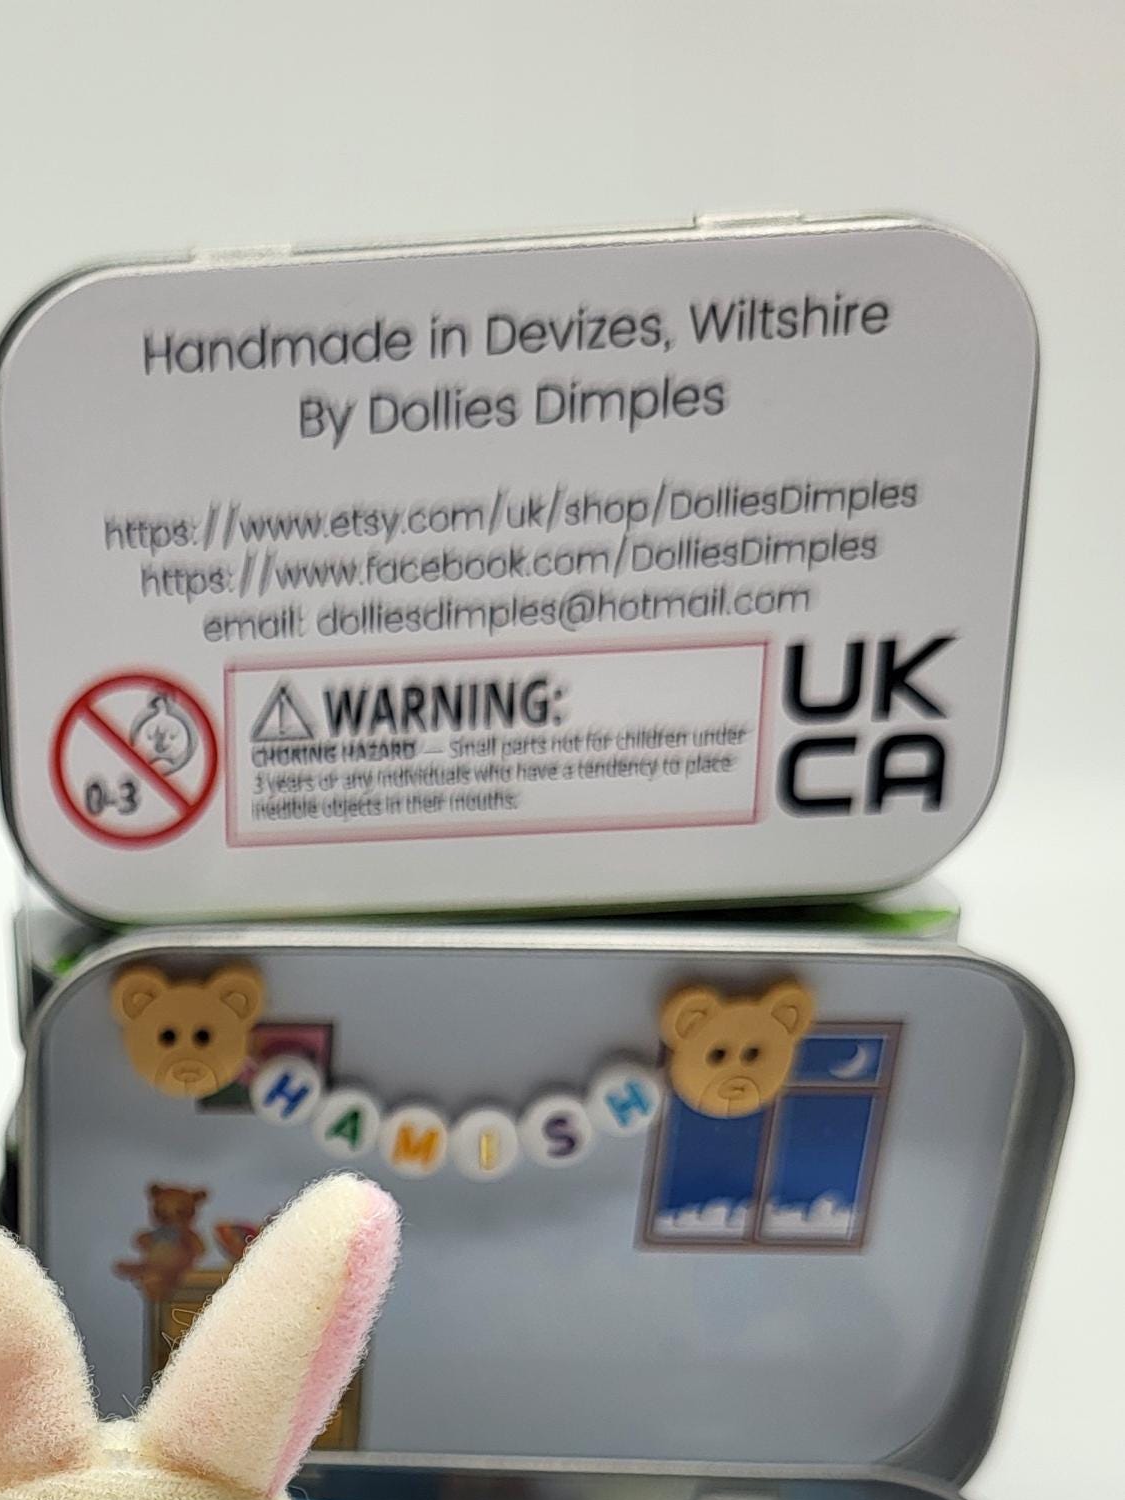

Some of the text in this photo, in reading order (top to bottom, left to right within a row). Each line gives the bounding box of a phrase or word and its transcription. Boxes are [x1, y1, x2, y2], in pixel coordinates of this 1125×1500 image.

[144, 291, 891, 376] Handmade in Devizes, Wiltshire
[299, 376, 727, 450] By Dollies Dimples
[103, 477, 918, 556] https://www.etsy.com/uk/shop/DolliesDimples
[140, 530, 878, 603] https://www.facebook.com/DolliesDimples
[203, 584, 812, 642] email: dolliesdimples@hotmail.com
[323, 678, 565, 738] WARNING:
[782, 635, 959, 725] UK
[251, 744, 336, 768] CHOKING
[342, 740, 416, 763] HAZARD
[449, 736, 497, 759] Small
[501, 734, 546, 760] parts
[616, 725, 689, 751] children
[692, 722, 746, 747] under
[776, 732, 946, 819] CA
[85, 781, 140, 817] 0-3
[263, 1070, 653, 1172] HAMISH
